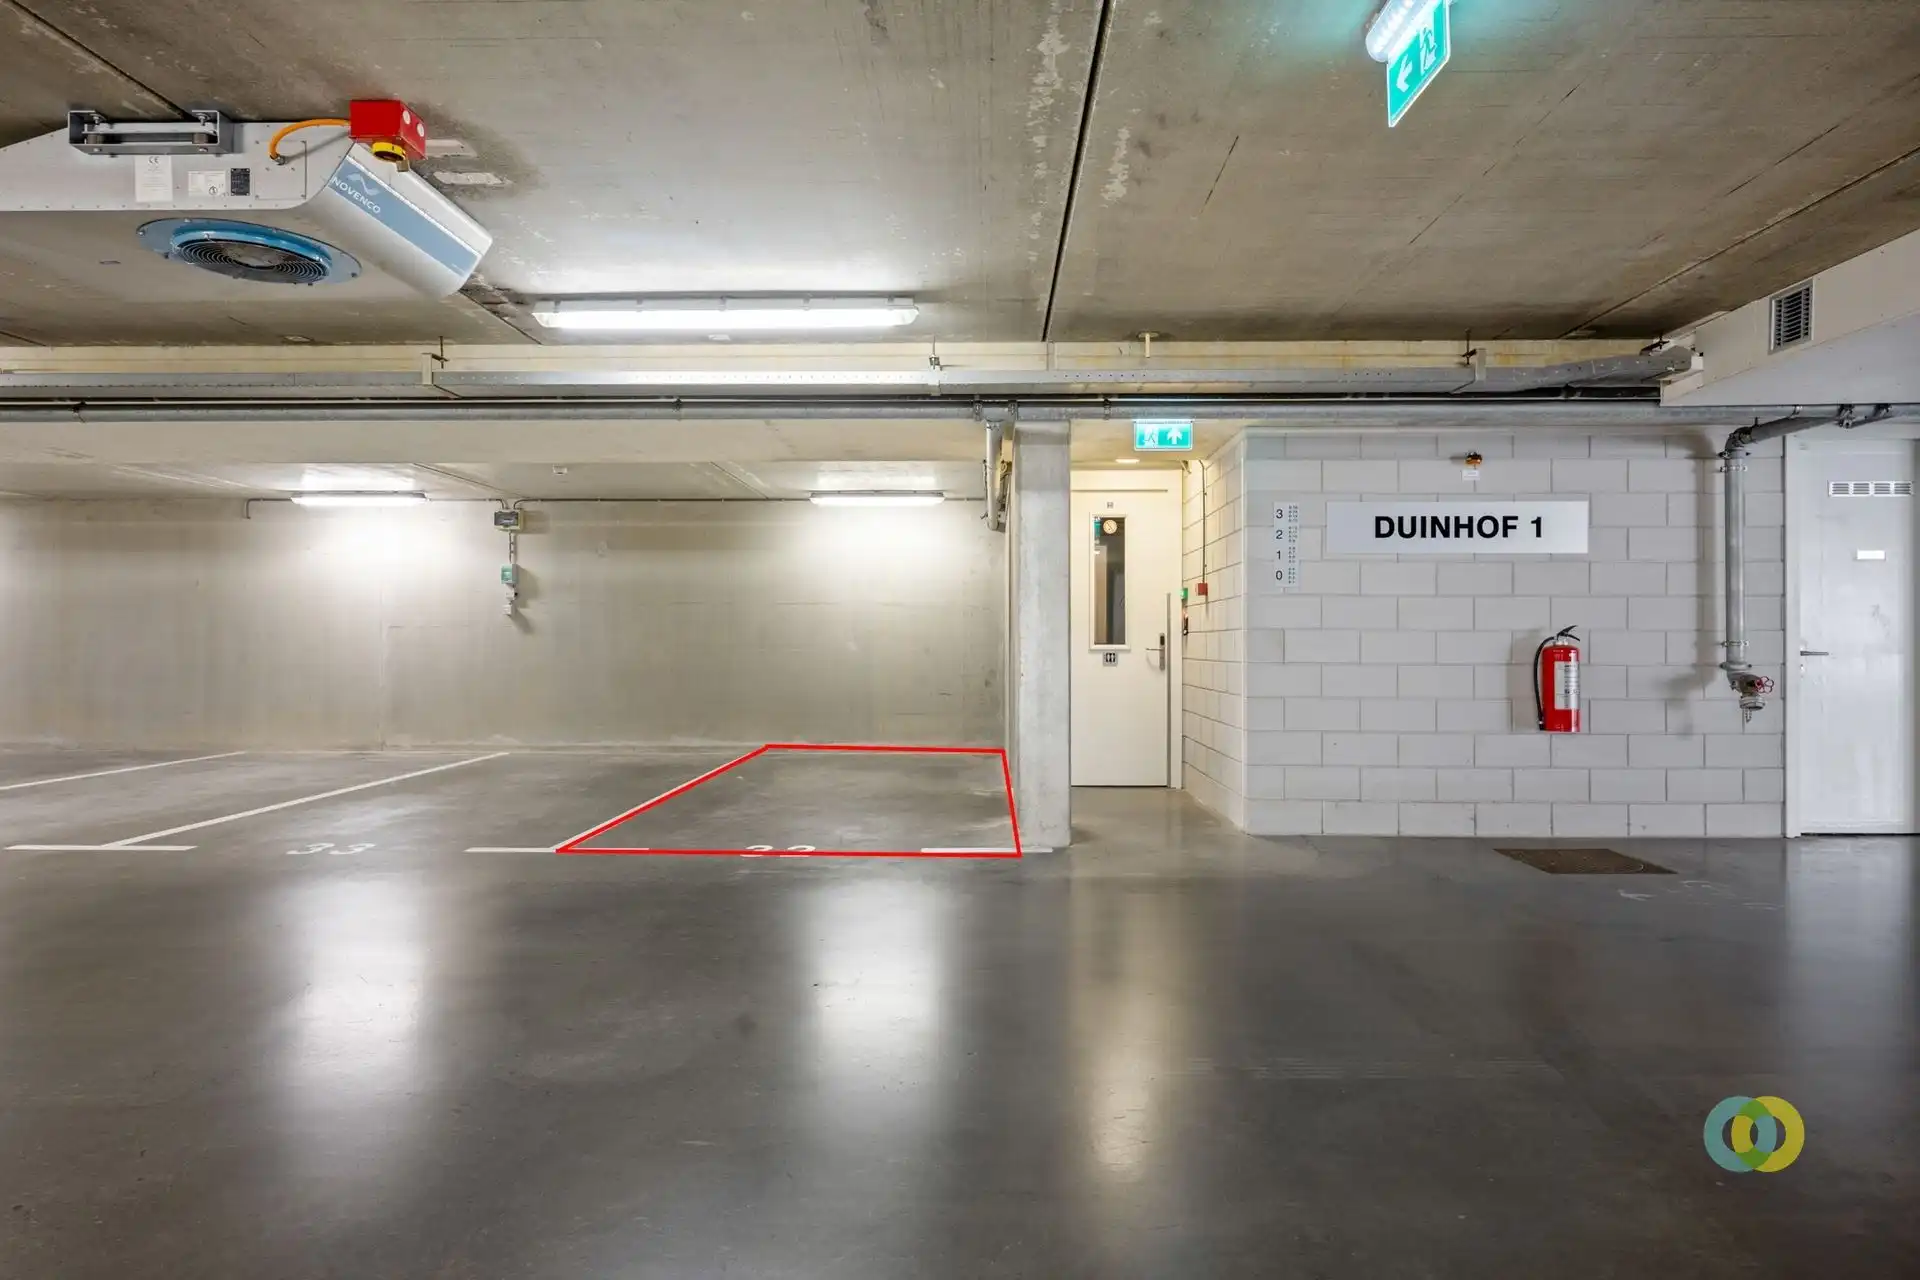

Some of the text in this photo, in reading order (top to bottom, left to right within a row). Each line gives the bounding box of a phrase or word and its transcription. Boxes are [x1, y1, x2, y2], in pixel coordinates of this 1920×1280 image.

[331, 176, 381, 214] NOVENCO
[1275, 508, 1283, 519] 3
[1374, 515, 1543, 539] DUINHOF 1
[1275, 529, 1283, 540] 2
[1276, 550, 1281, 560] 1
[1275, 570, 1283, 581] 0
[286, 842, 376, 855] 33
